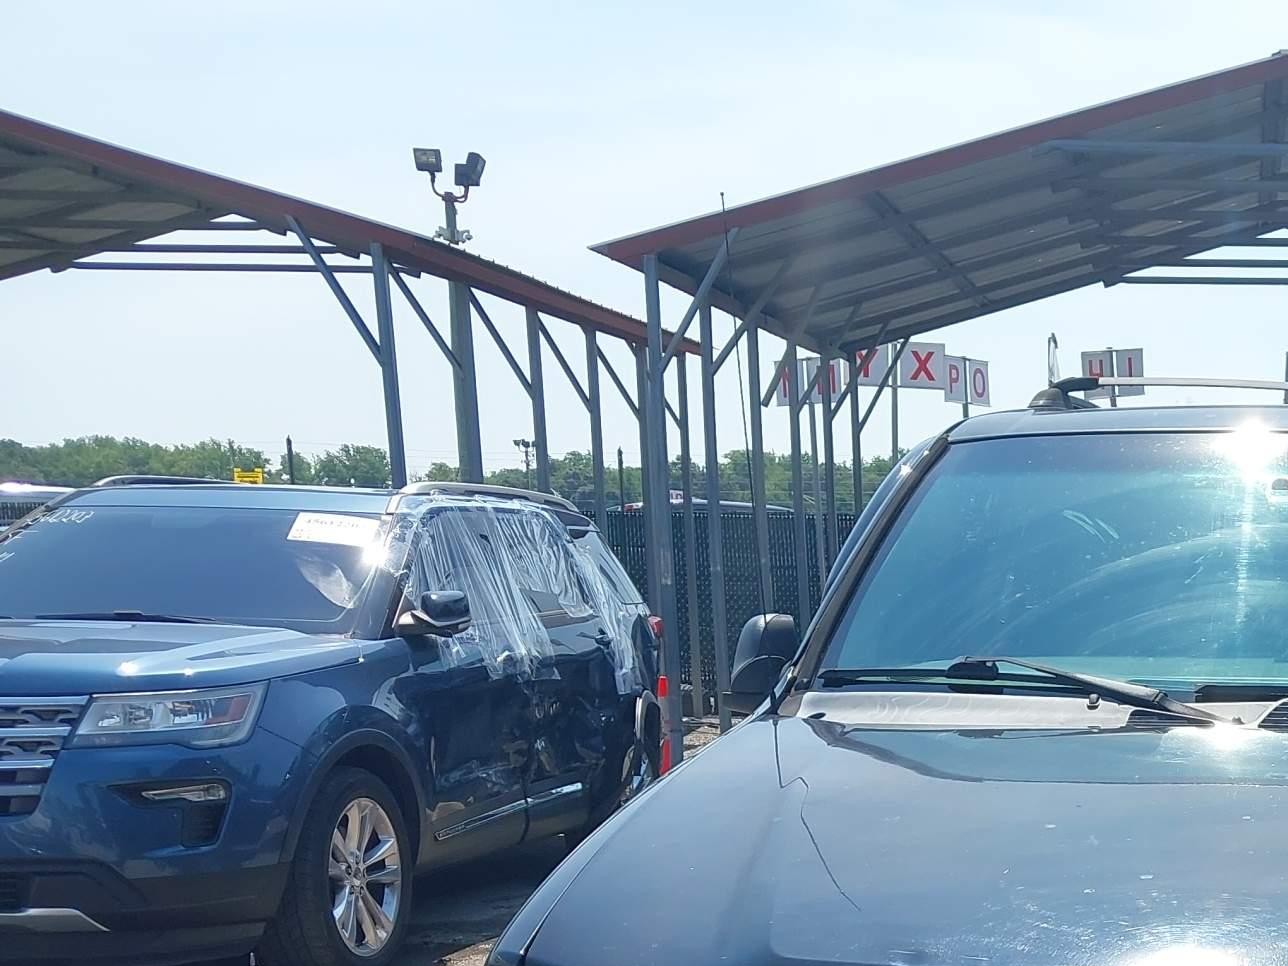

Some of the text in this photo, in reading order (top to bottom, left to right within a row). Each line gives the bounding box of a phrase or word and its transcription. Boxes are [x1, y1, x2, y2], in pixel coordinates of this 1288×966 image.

[910, 350, 935, 381] X
[948, 363, 960, 394] P
[972, 367, 986, 398] O
